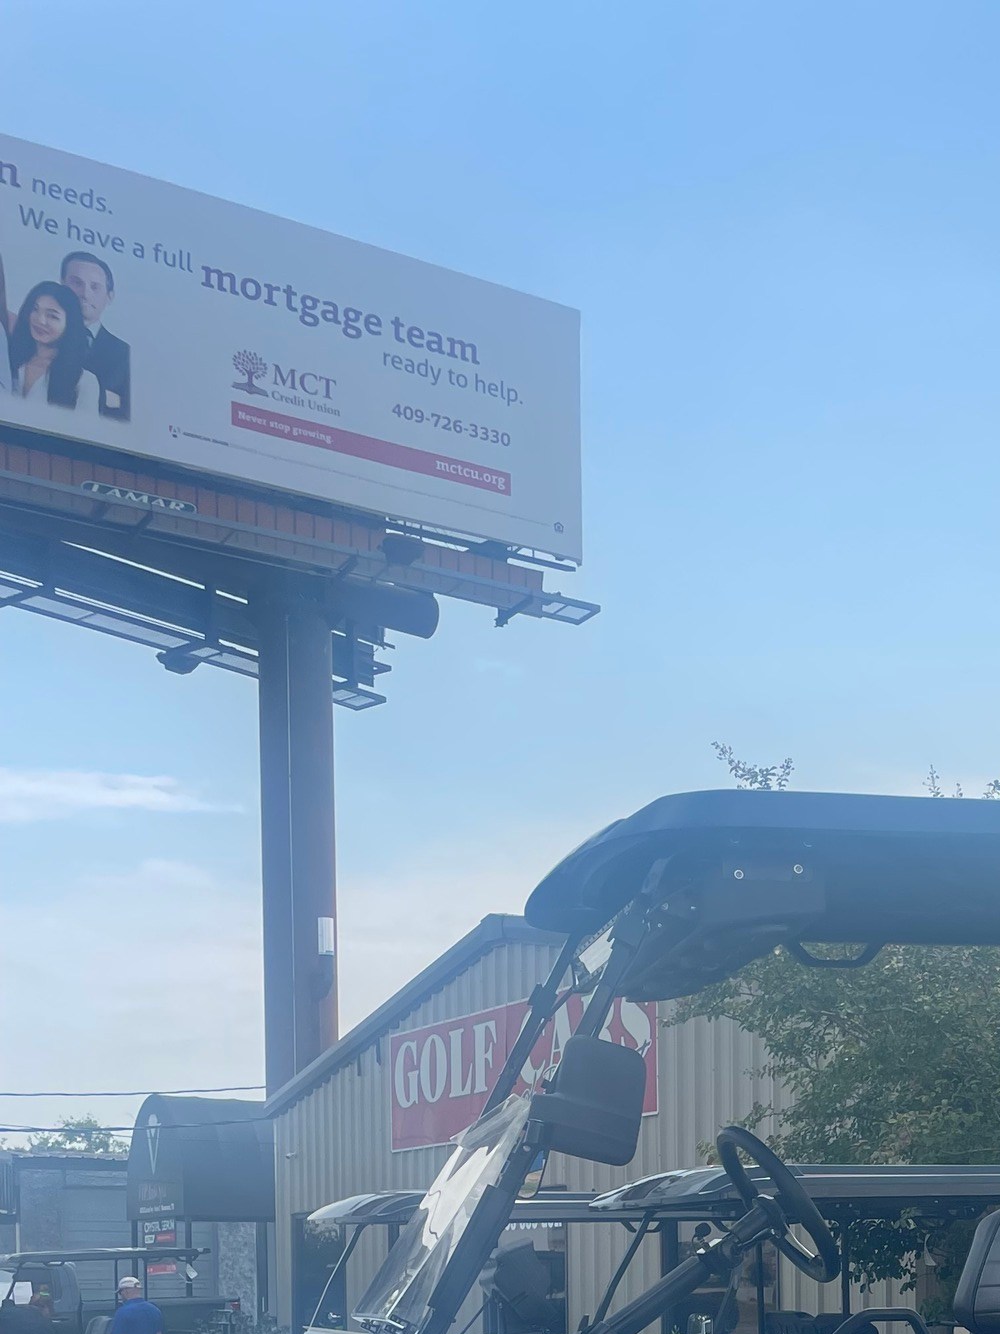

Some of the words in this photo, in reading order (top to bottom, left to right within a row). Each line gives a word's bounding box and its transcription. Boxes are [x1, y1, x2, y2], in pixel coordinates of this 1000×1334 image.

[32, 178, 113, 214] needs.
[19, 204, 58, 234] We
[67, 218, 125, 253] have
[132, 242, 145, 259] a
[153, 243, 193, 273] full
[201, 265, 383, 339] mortgage
[391, 316, 480, 365] team
[272, 363, 337, 400] MCT
[383, 352, 441, 386] ready
[448, 369, 468, 388] to
[475, 373, 523, 406] help.
[271, 391, 305, 407] Credit
[308, 400, 341, 417] Union
[238, 411, 267, 427] Never
[269, 421, 291, 435] stop
[392, 403, 511, 447] 409-726-3330
[435, 459, 506, 490] mctcu.org
[395, 1020, 497, 1109] GOLF
[519, 993, 652, 1085] CAS
